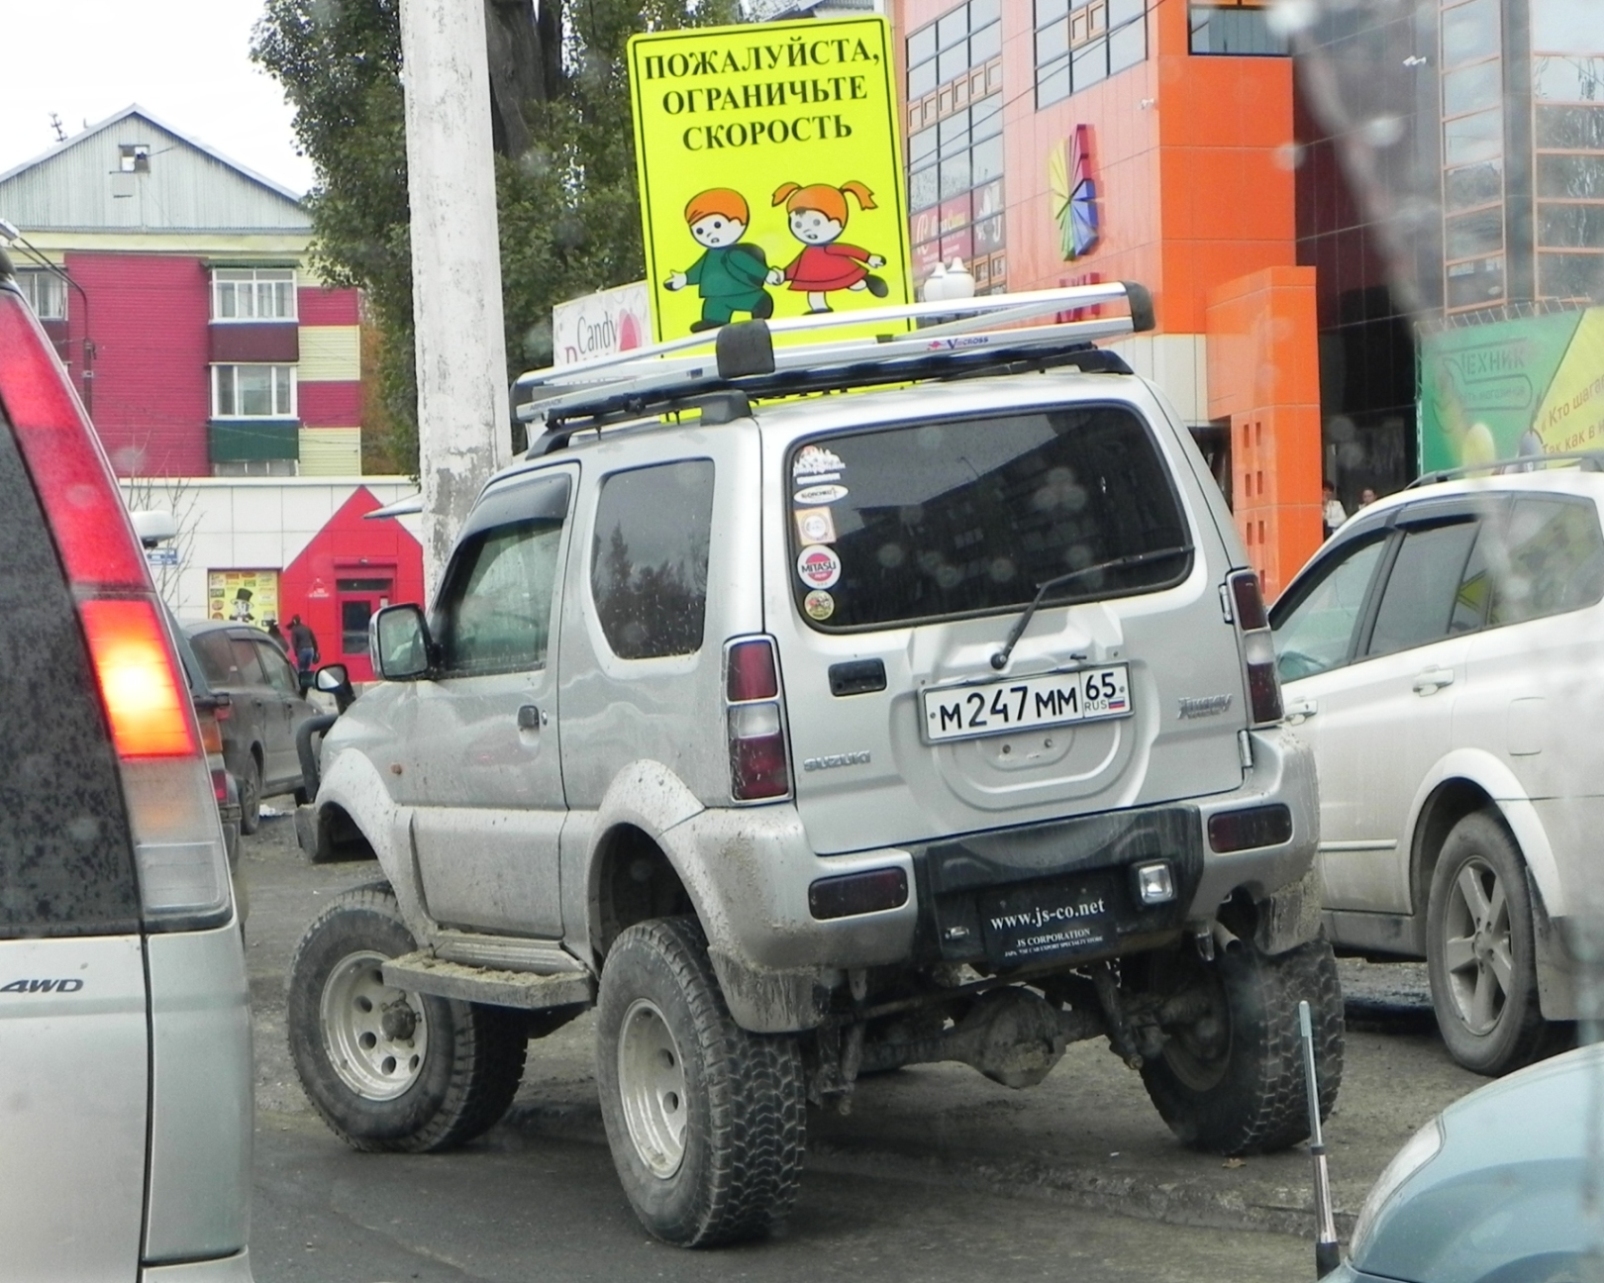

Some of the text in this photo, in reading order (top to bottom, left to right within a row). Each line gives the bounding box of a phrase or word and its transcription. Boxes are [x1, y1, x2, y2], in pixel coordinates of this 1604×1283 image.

[645, 36, 880, 80] ПОЖАЛУЙСТА,
[662, 75, 868, 115] ОГРАНИЧЬТЕ
[682, 114, 853, 151] СКОРОСТЬ
[577, 311, 618, 355] Candy
[1549, 402, 1570, 427] Кто
[1564, 430, 1585, 451] как
[801, 561, 837, 573] MITASU
[1085, 672, 1116, 701] 65
[1084, 699, 1108, 711] RUS
[990, 898, 1106, 931] www.js-co.net
[1016, 928, 1091, 948] JS CORPORATION
[0, 979, 84, 993] 4WD
